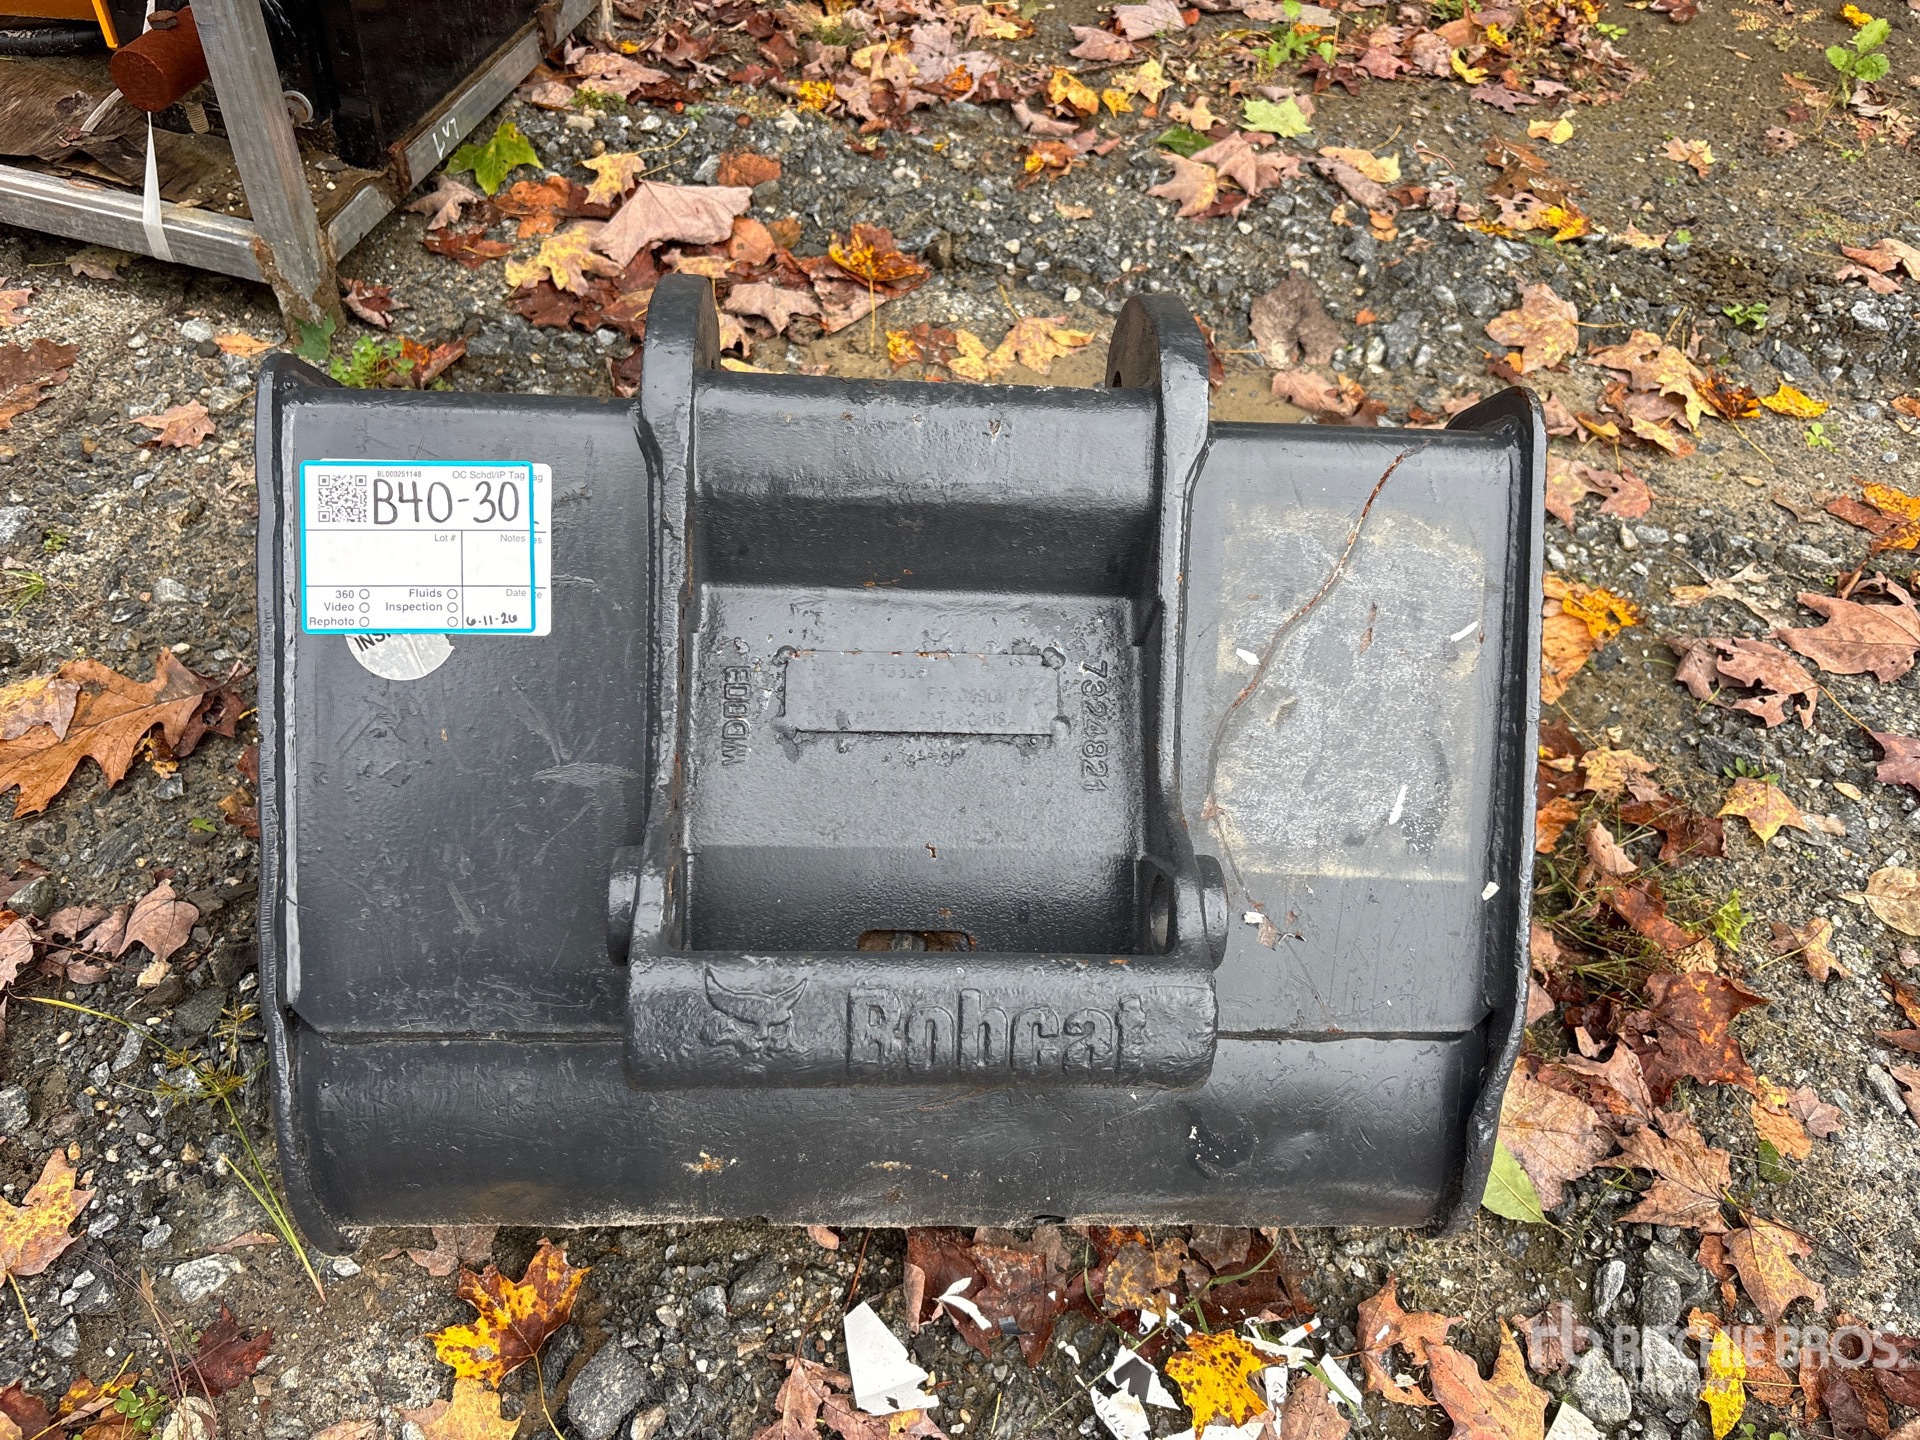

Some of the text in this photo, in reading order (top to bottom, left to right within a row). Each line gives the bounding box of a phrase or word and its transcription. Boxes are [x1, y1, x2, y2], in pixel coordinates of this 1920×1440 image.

[377, 470, 422, 478] BL000251148
[452, 470, 467, 479] OC
[509, 472, 526, 482] Tag
[373, 478, 520, 525] B40-30
[434, 533, 456, 543] Lot #
[500, 533, 526, 543] Notes
[335, 590, 355, 599] 360
[408, 589, 443, 598] Fluids
[505, 588, 527, 597] Date
[323, 602, 355, 612] Video
[385, 602, 443, 613] Inspection
[308, 617, 355, 627] Rephoto
